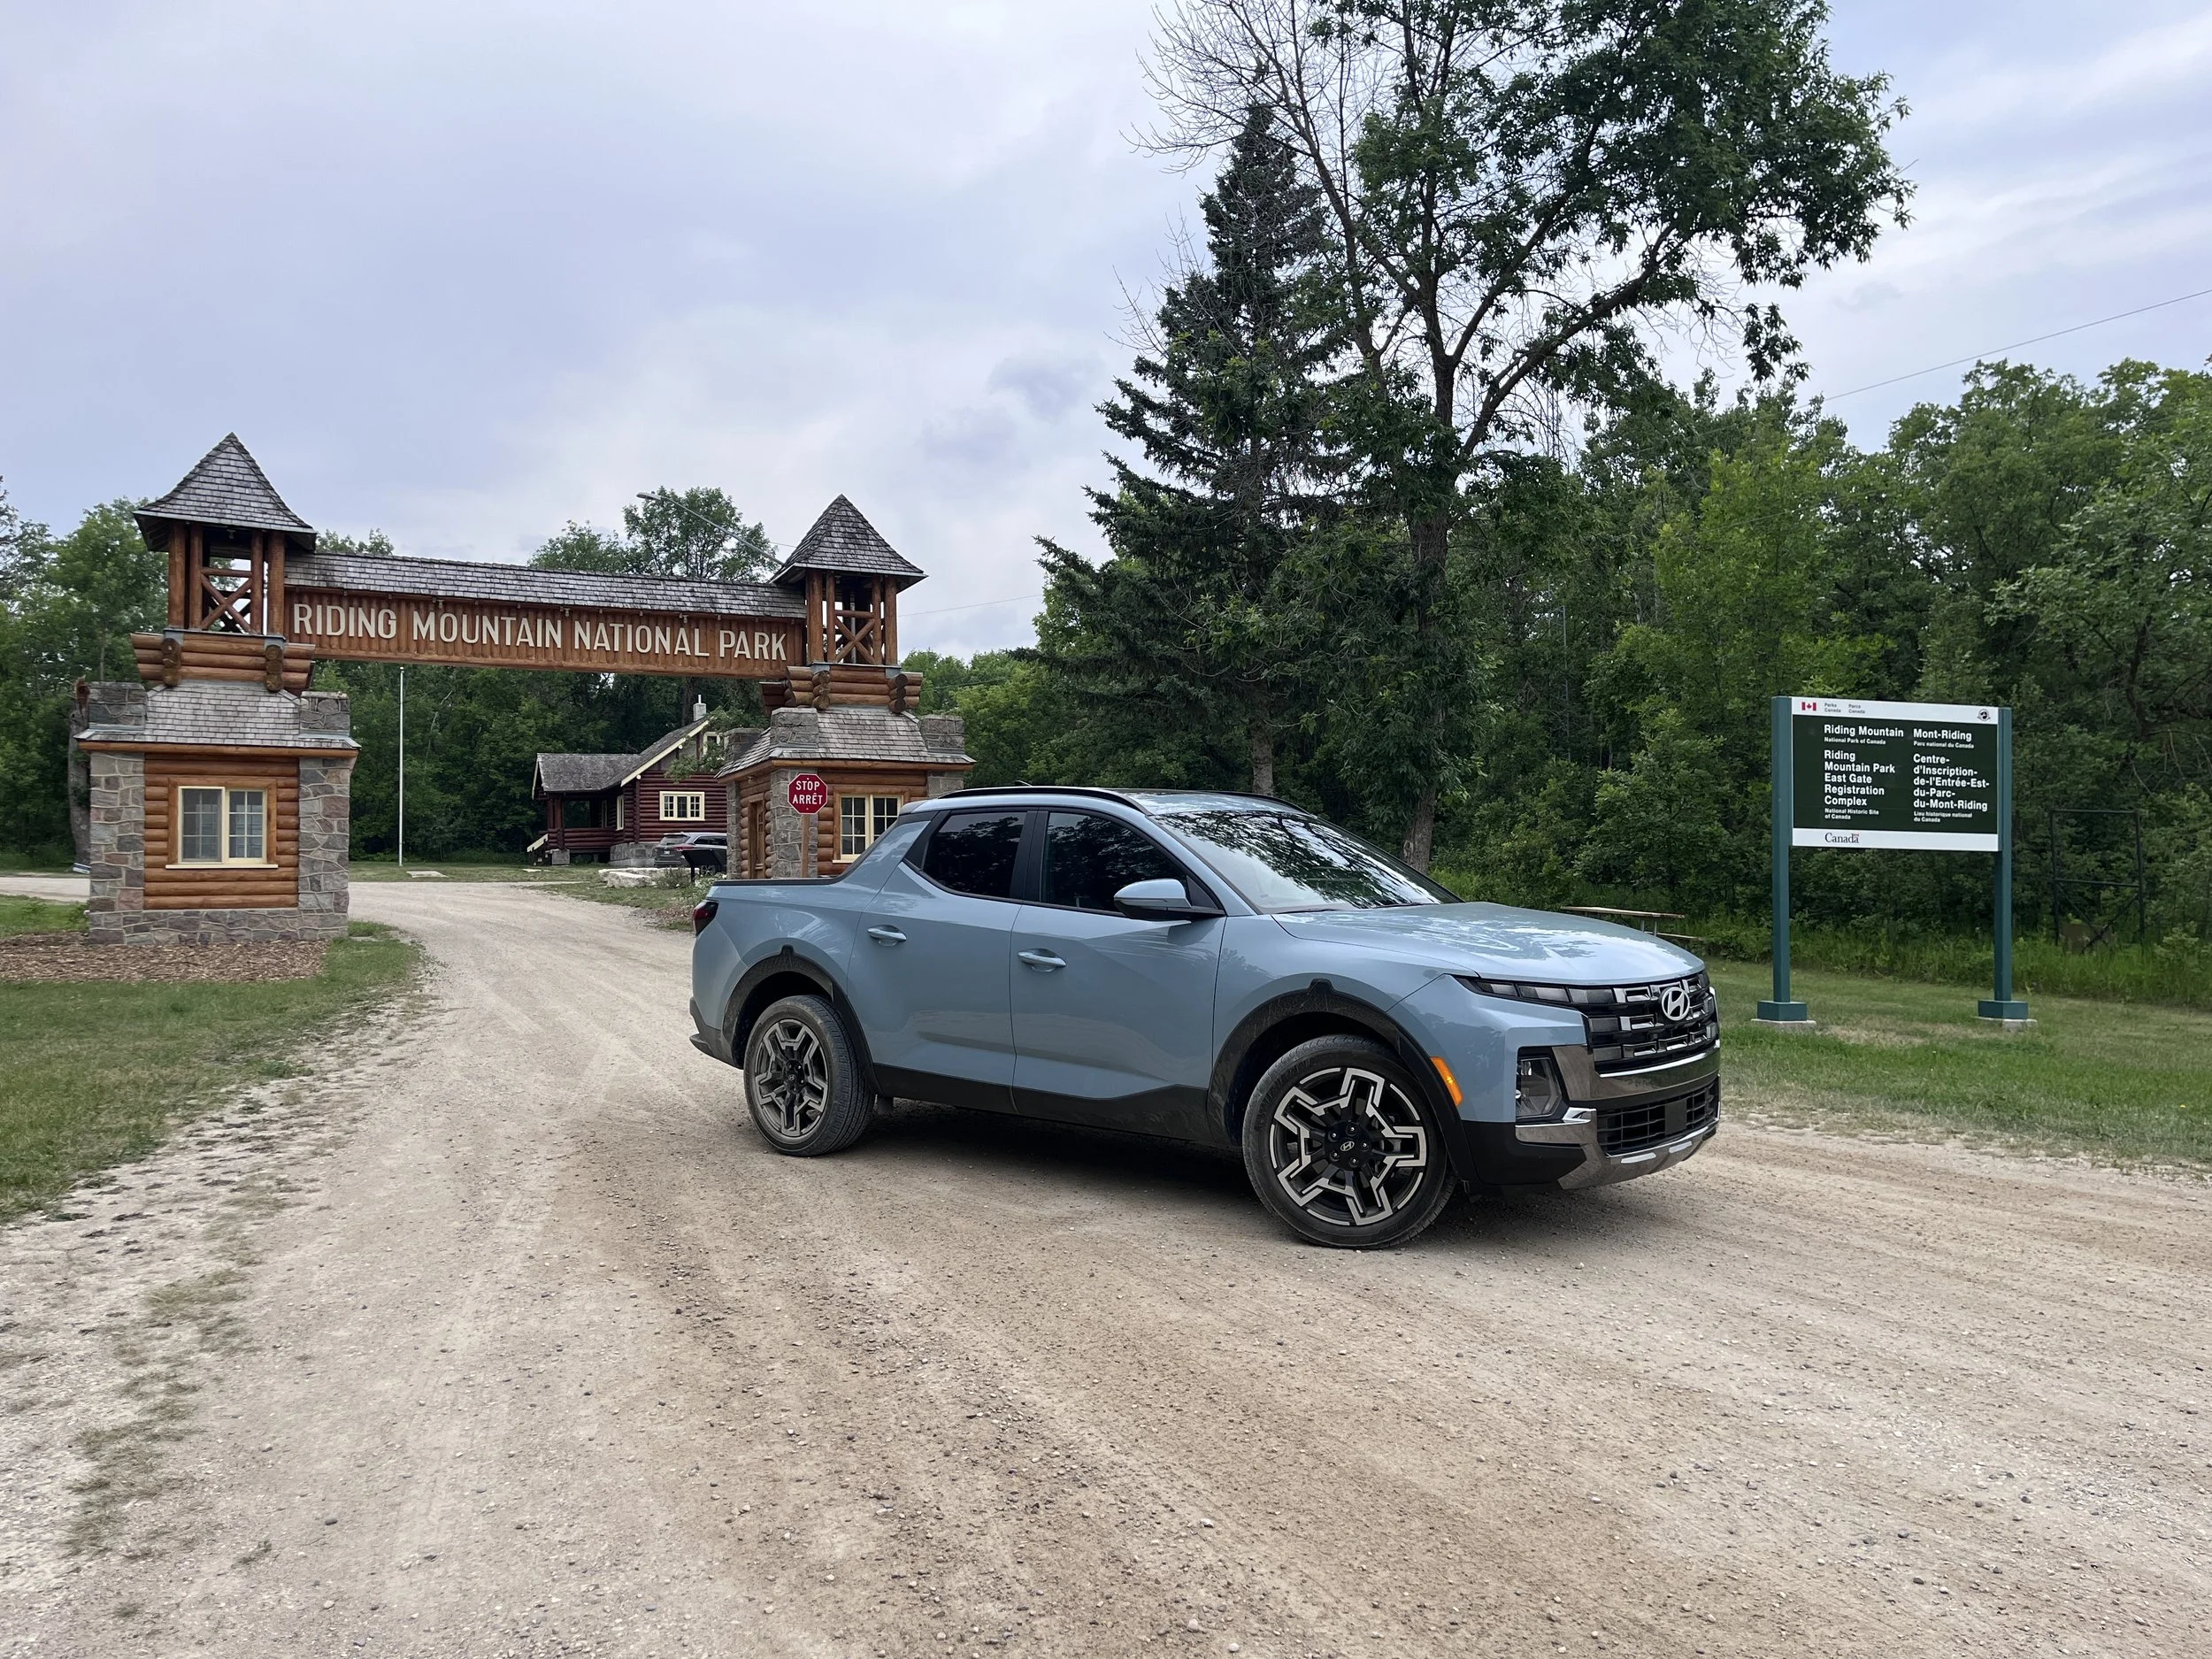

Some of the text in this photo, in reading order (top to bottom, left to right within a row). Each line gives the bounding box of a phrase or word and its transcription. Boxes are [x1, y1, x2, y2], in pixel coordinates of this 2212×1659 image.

[293, 603, 787, 662] RIDING MOUNTAIN NATIONAL PARK
[1824, 724, 1904, 737] Riding Mountain
[1913, 728, 1972, 742] Mont-Riding
[1824, 749, 1855, 762] Riding
[1913, 753, 1950, 764] Centre-
[1824, 761, 1895, 773] Mountain Park
[1913, 764, 1978, 777] d'Inscription-
[1824, 772, 1872, 783] East Gate
[1913, 776, 1990, 787] de-l'Entrée-Est-
[795, 780, 820, 791] STOP
[1824, 783, 1885, 795] Registration
[1913, 787, 1956, 798] du-Parc-
[792, 793, 823, 805] ARRÊT
[1824, 795, 1868, 807] Complex
[1913, 798, 1988, 812] du-Mont-Riding
[1824, 832, 1860, 843] Canada
